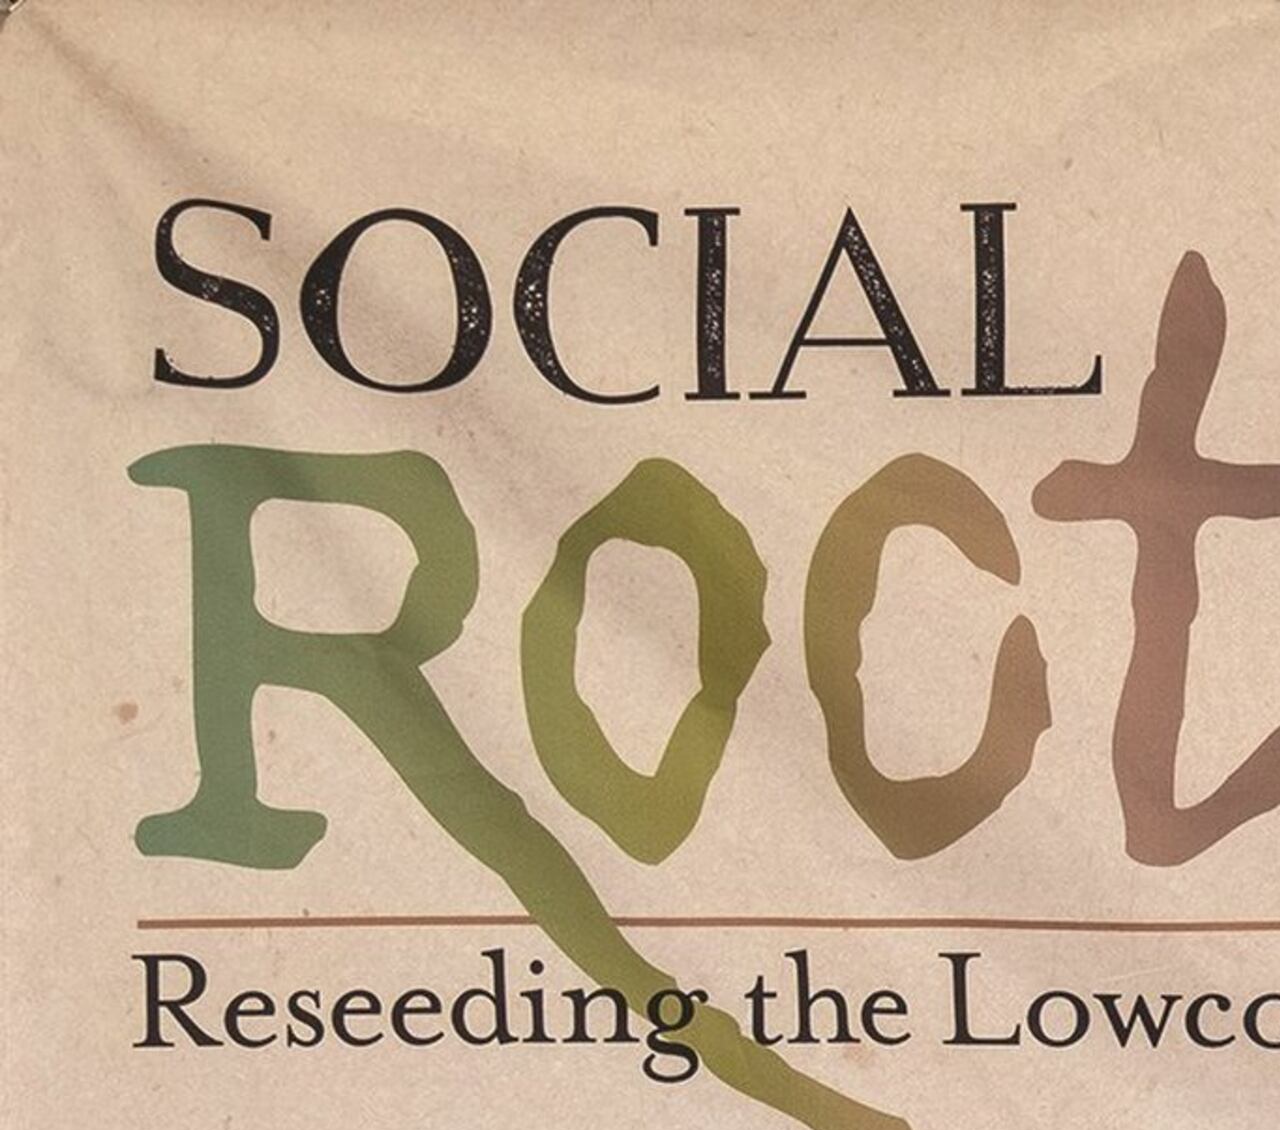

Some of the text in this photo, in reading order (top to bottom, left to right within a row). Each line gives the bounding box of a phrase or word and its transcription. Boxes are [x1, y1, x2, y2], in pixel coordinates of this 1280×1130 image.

[150, 198, 1104, 404] SOCIAL
[132, 950, 712, 1084] Reseeding
[741, 948, 910, 1048] the
